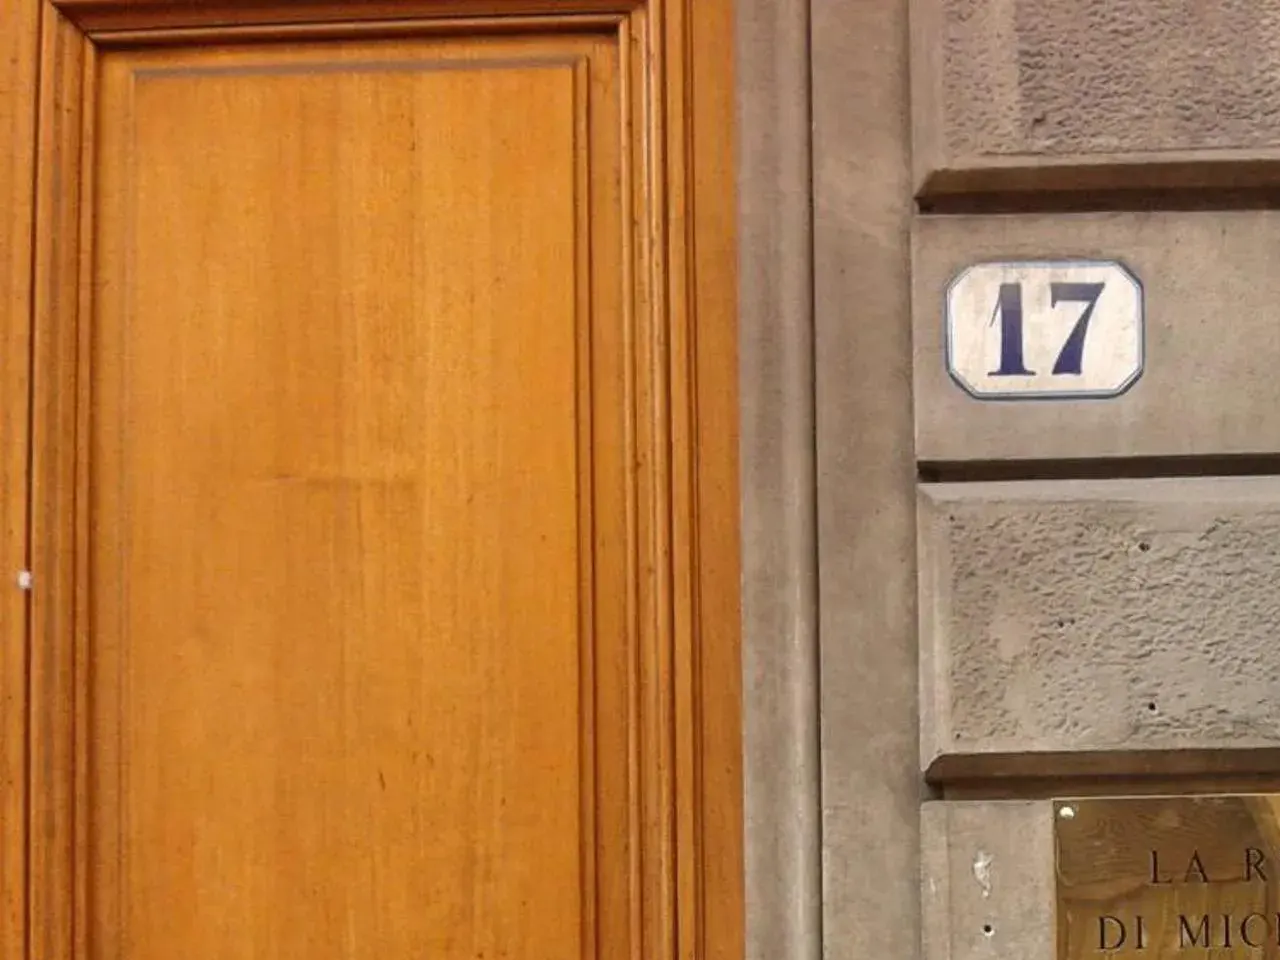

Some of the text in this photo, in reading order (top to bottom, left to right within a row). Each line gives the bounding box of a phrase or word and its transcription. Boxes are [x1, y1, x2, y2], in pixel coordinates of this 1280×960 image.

[987, 282, 1106, 376] 17
[1150, 848, 1210, 885] LA
[1097, 915, 1146, 951] DI
